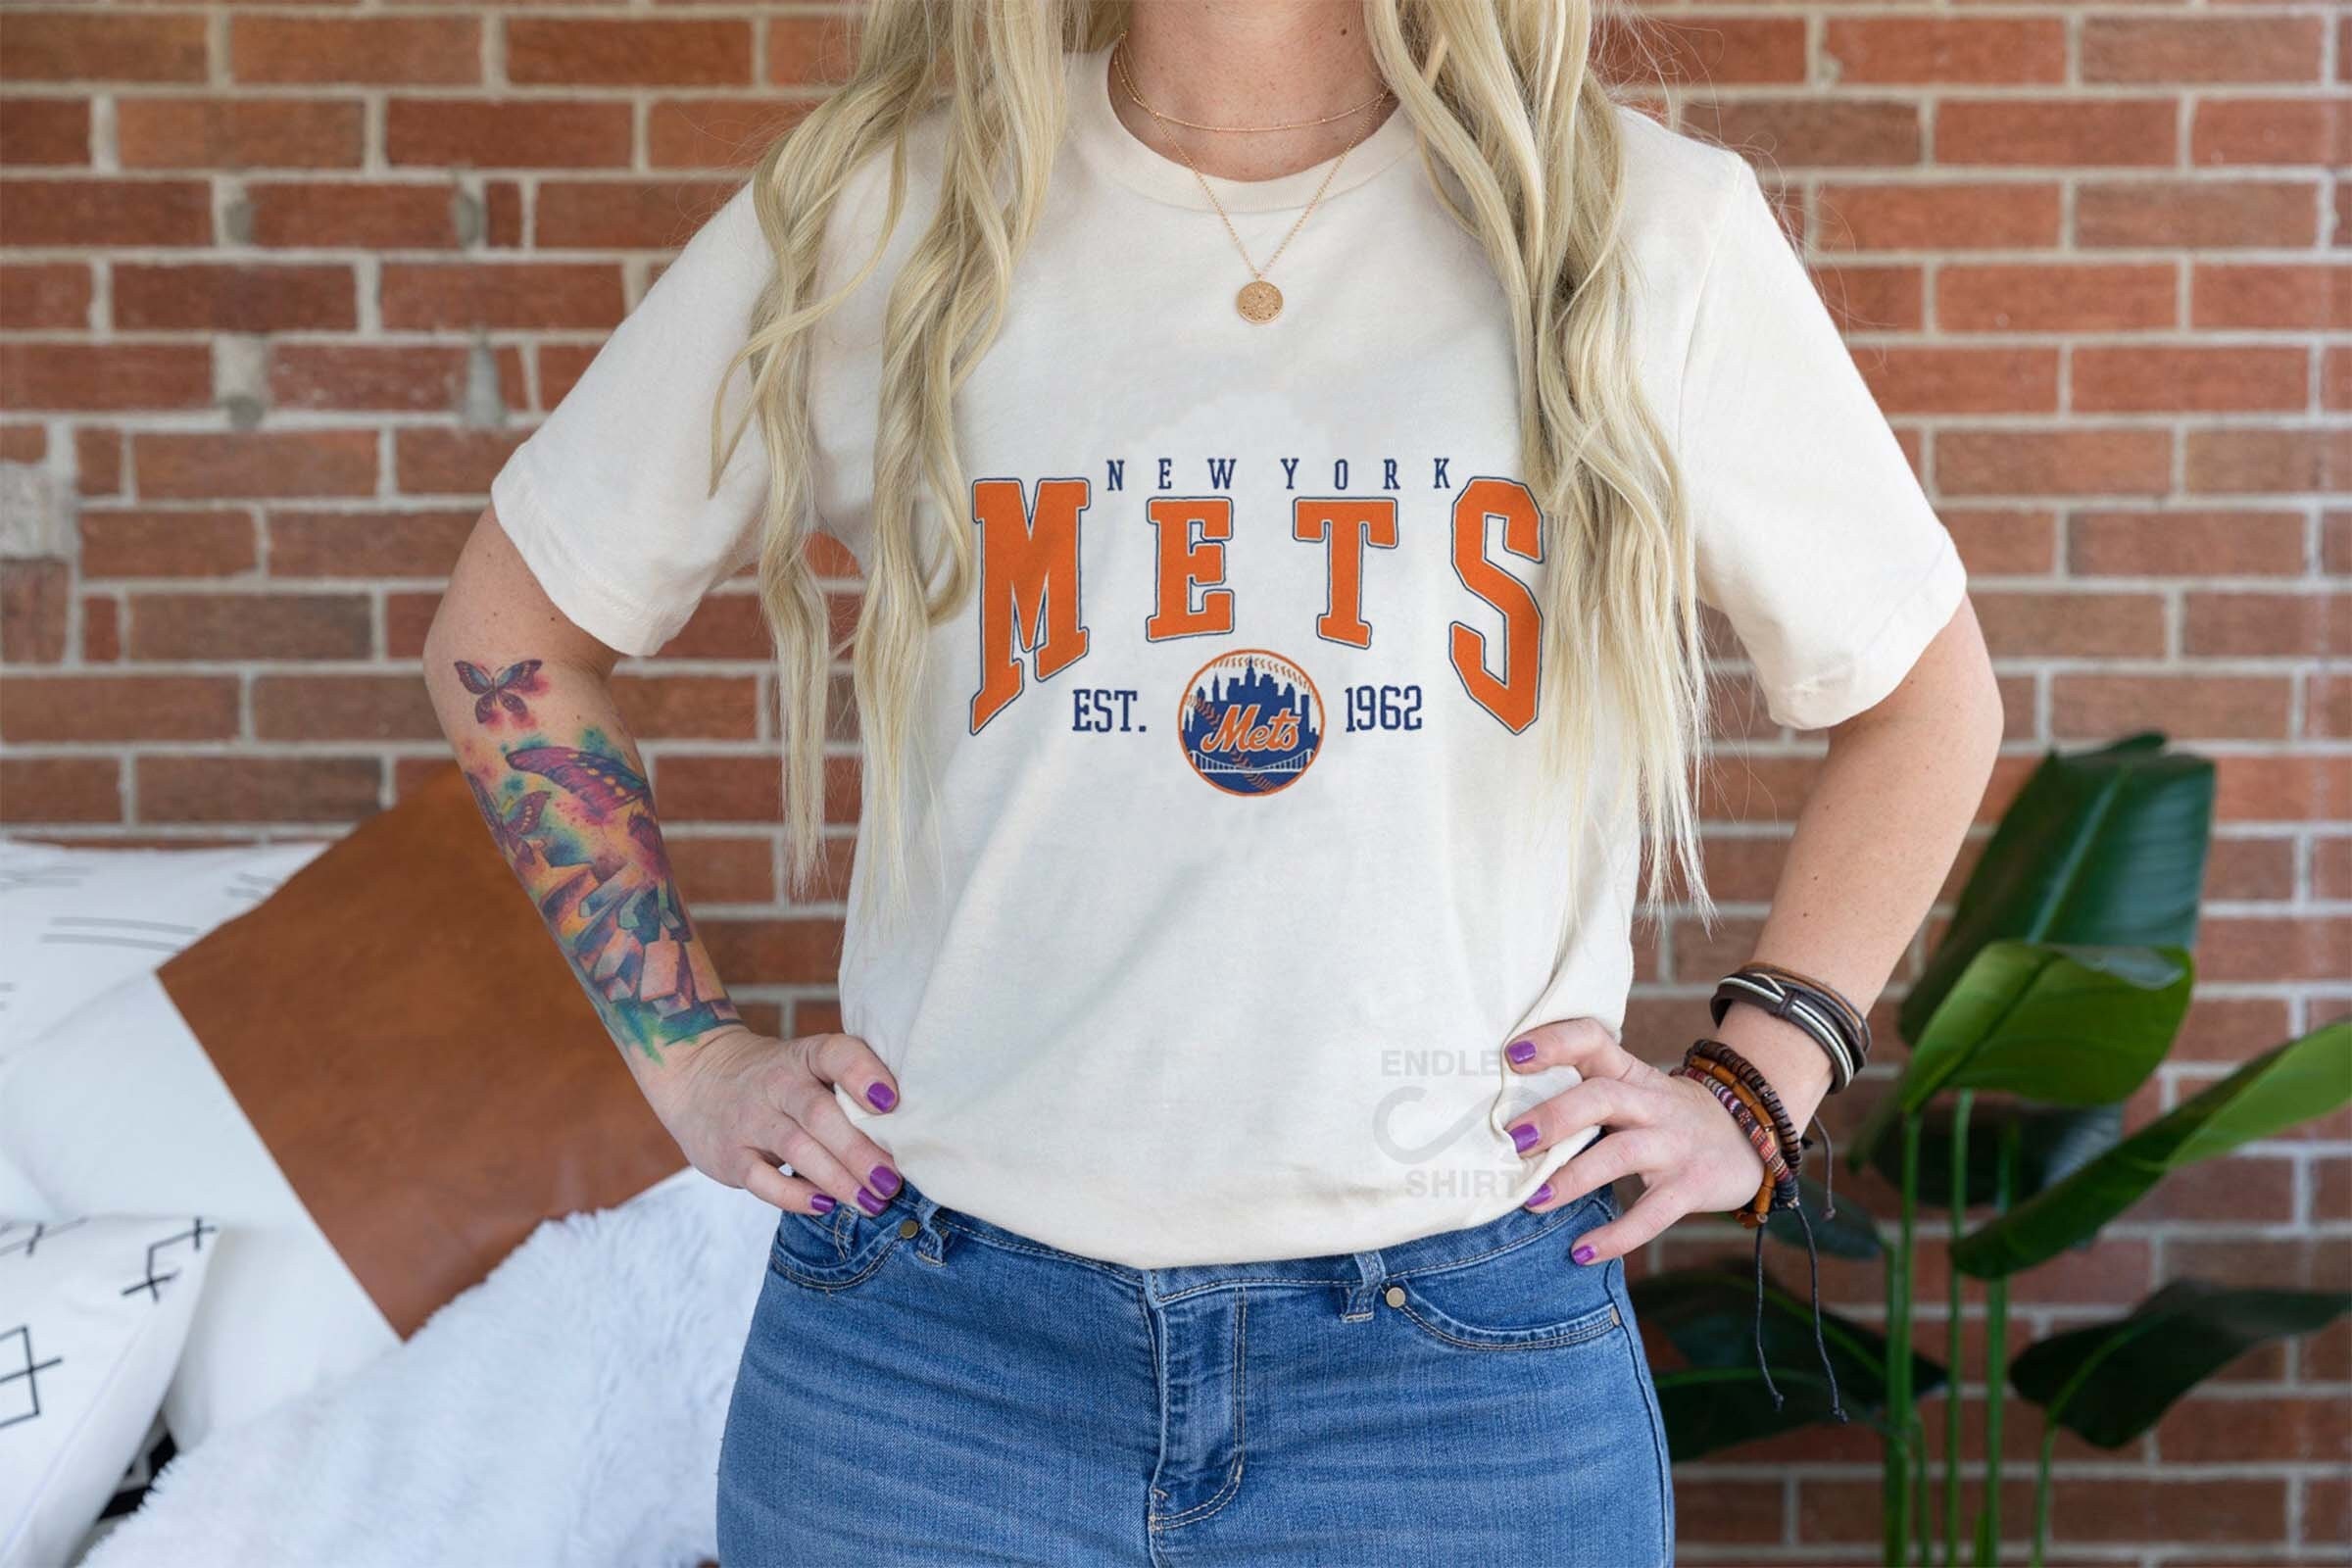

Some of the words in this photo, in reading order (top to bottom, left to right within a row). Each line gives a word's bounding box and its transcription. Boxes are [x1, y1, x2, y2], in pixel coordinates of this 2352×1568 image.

[1107, 459, 1236, 490] NEW
[1281, 458, 1451, 489] YORK
[970, 477, 1544, 735] METS
[1072, 688, 1147, 732] EST.
[1345, 685, 1423, 732] 1962
[1201, 705, 1301, 752] Mets
